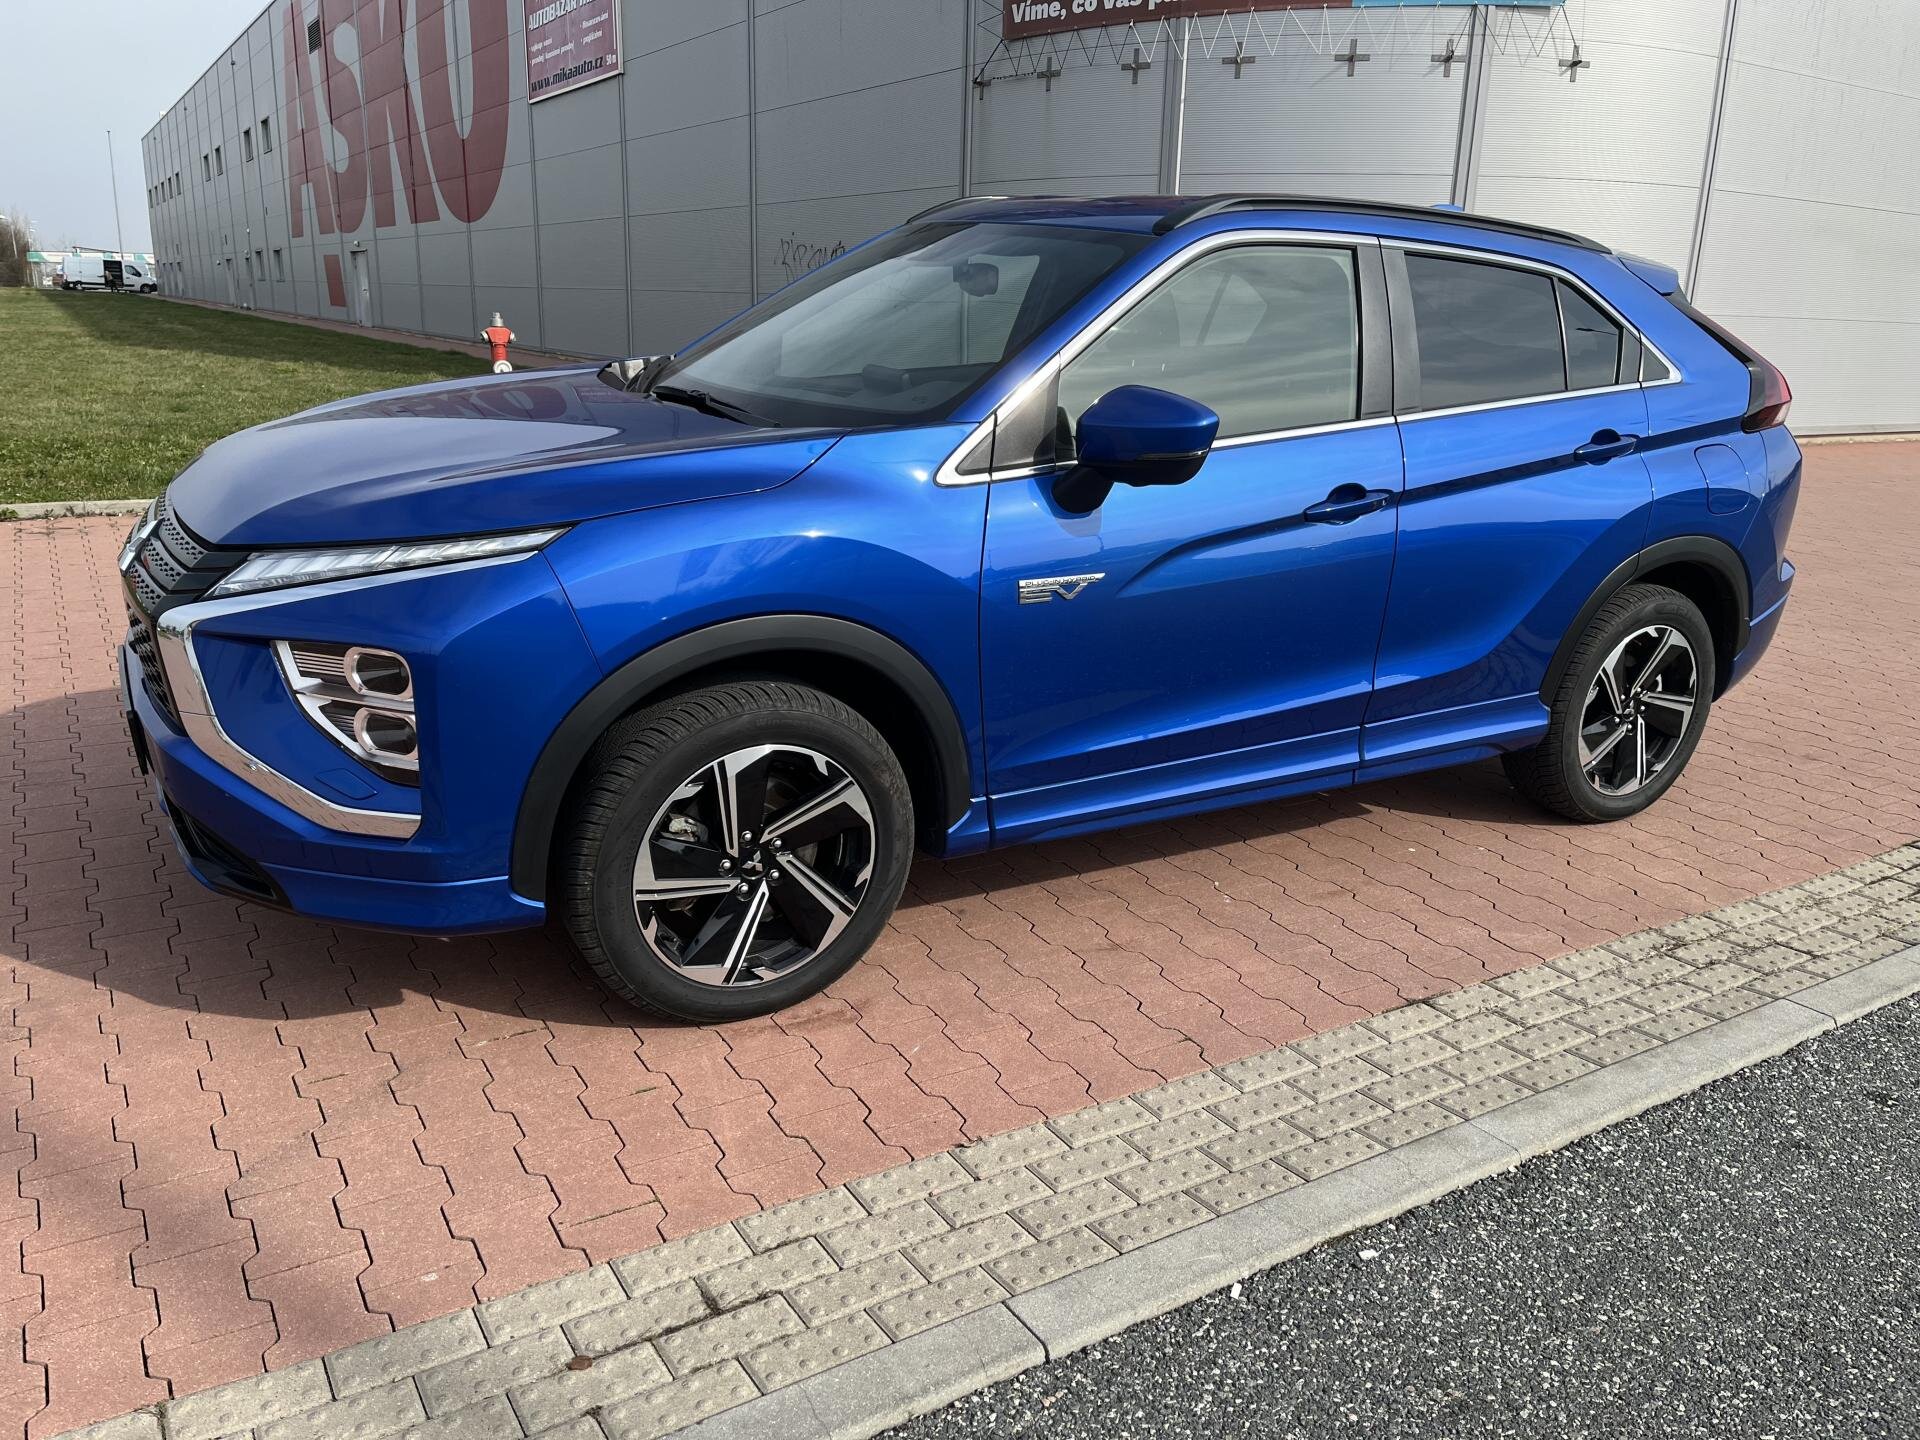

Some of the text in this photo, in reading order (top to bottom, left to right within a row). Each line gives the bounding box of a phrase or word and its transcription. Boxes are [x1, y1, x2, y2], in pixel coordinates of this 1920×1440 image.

[1011, 1, 1066, 23] Víme,
[1072, 0, 1098, 14] co
[531, 56, 604, 93] www.mikaauto.cz
[1019, 583, 1088, 605] EV
